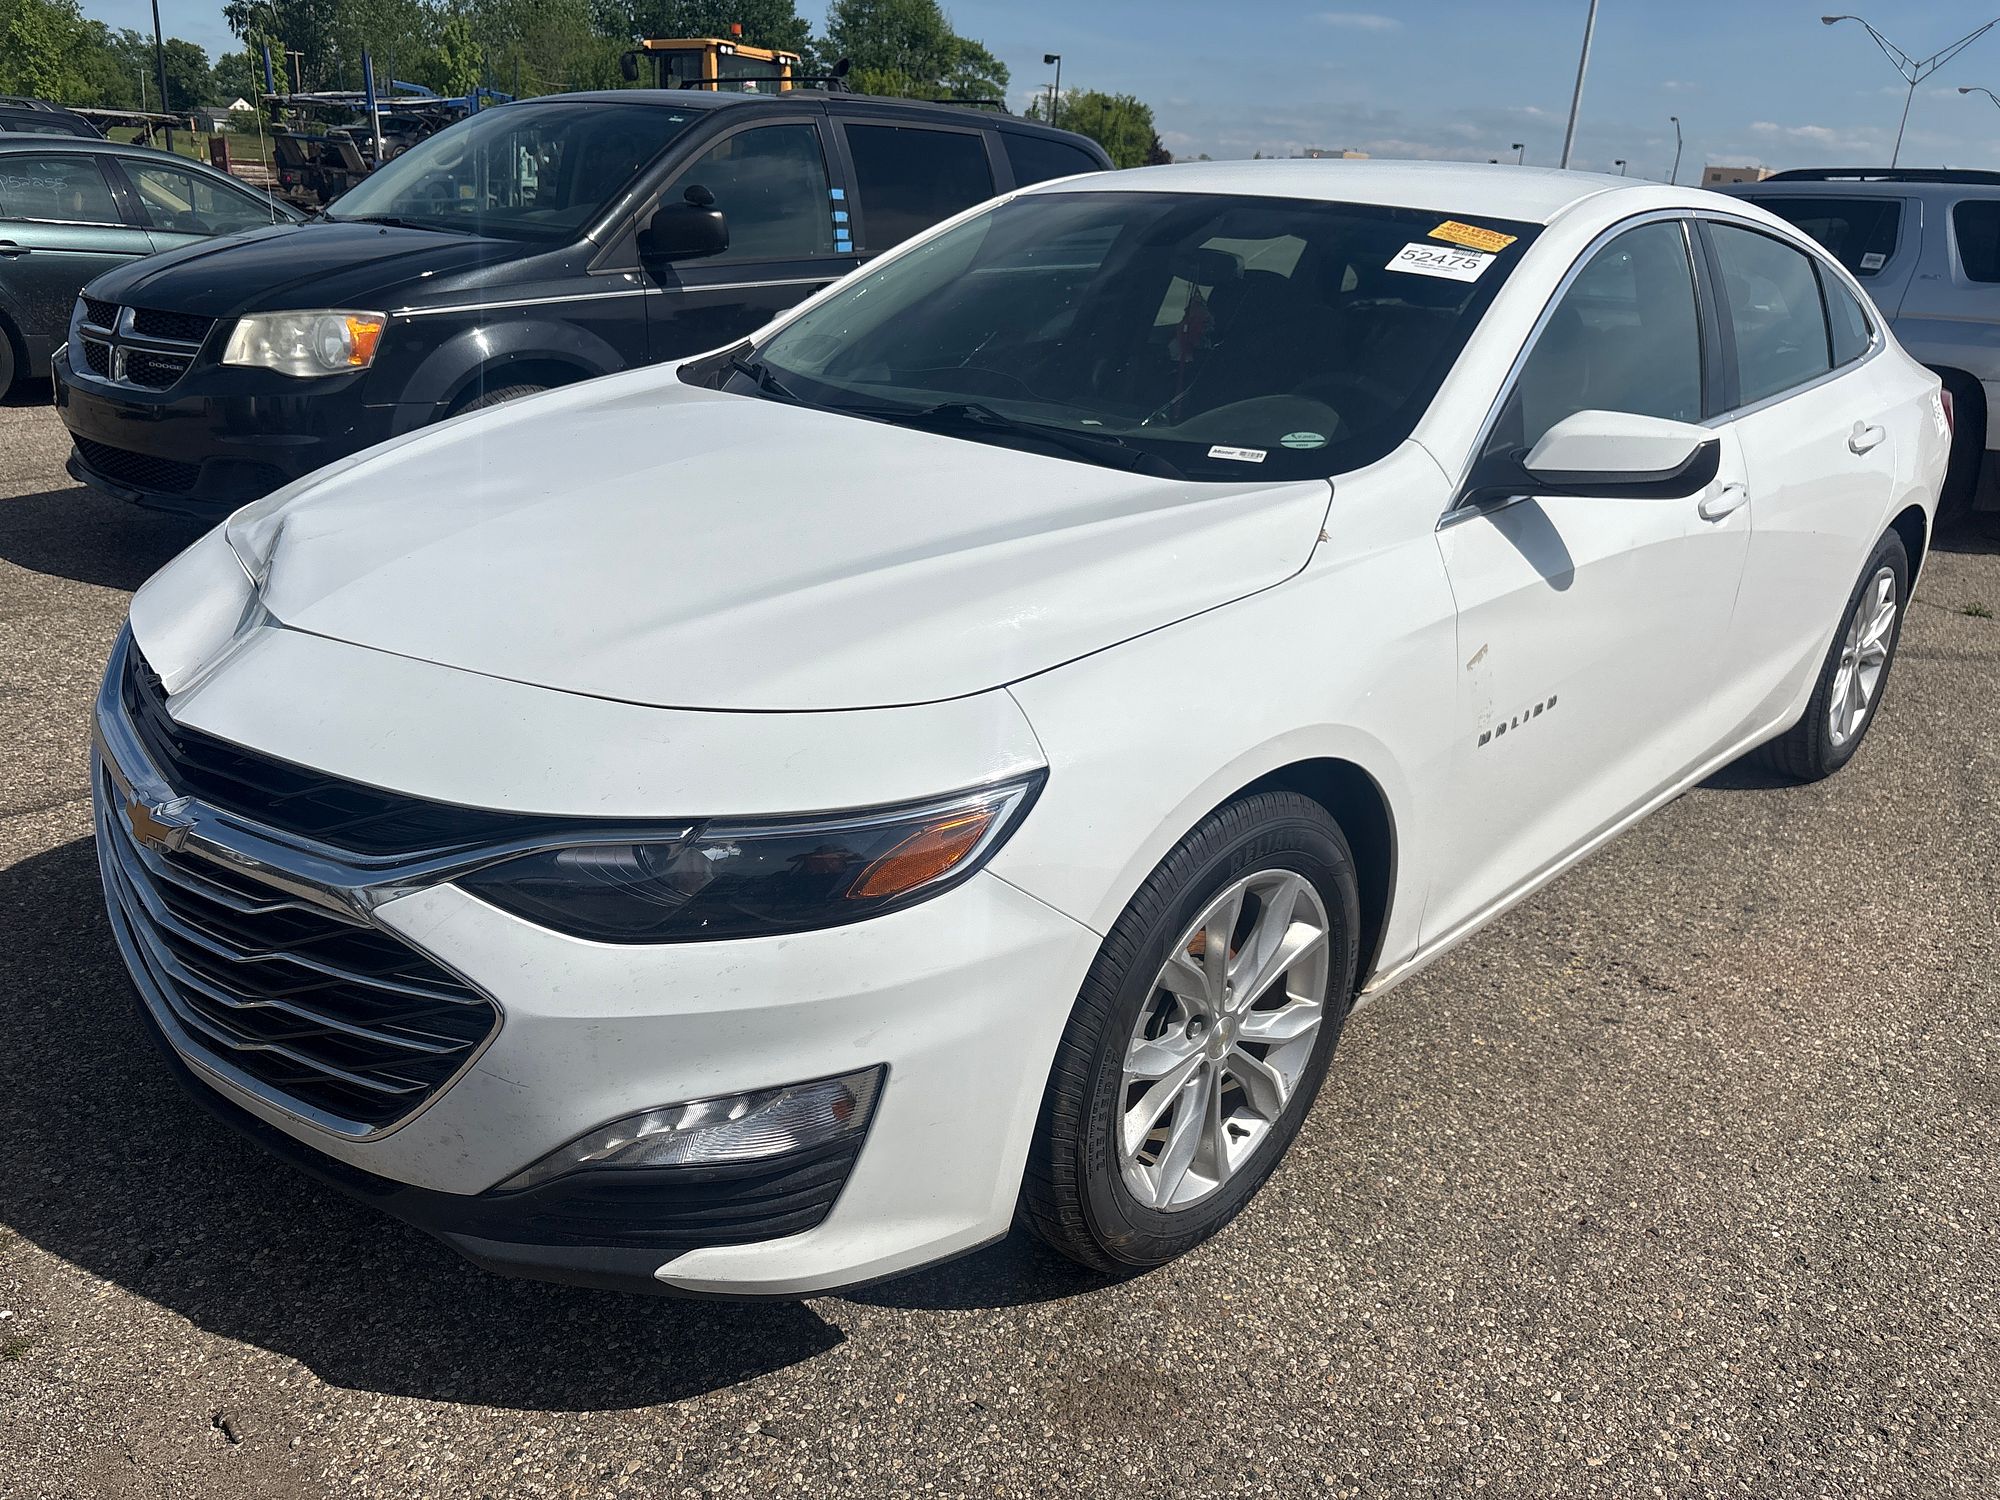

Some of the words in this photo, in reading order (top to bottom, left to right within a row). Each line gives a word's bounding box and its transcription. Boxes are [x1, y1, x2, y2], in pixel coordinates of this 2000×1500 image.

[1448, 222, 1470, 231] THIS
[1470, 228, 1513, 243] VEHICLE
[1400, 249, 1480, 269] 52475
[148, 361, 184, 371] DODGE
[1478, 695, 1557, 747] MALIBU
